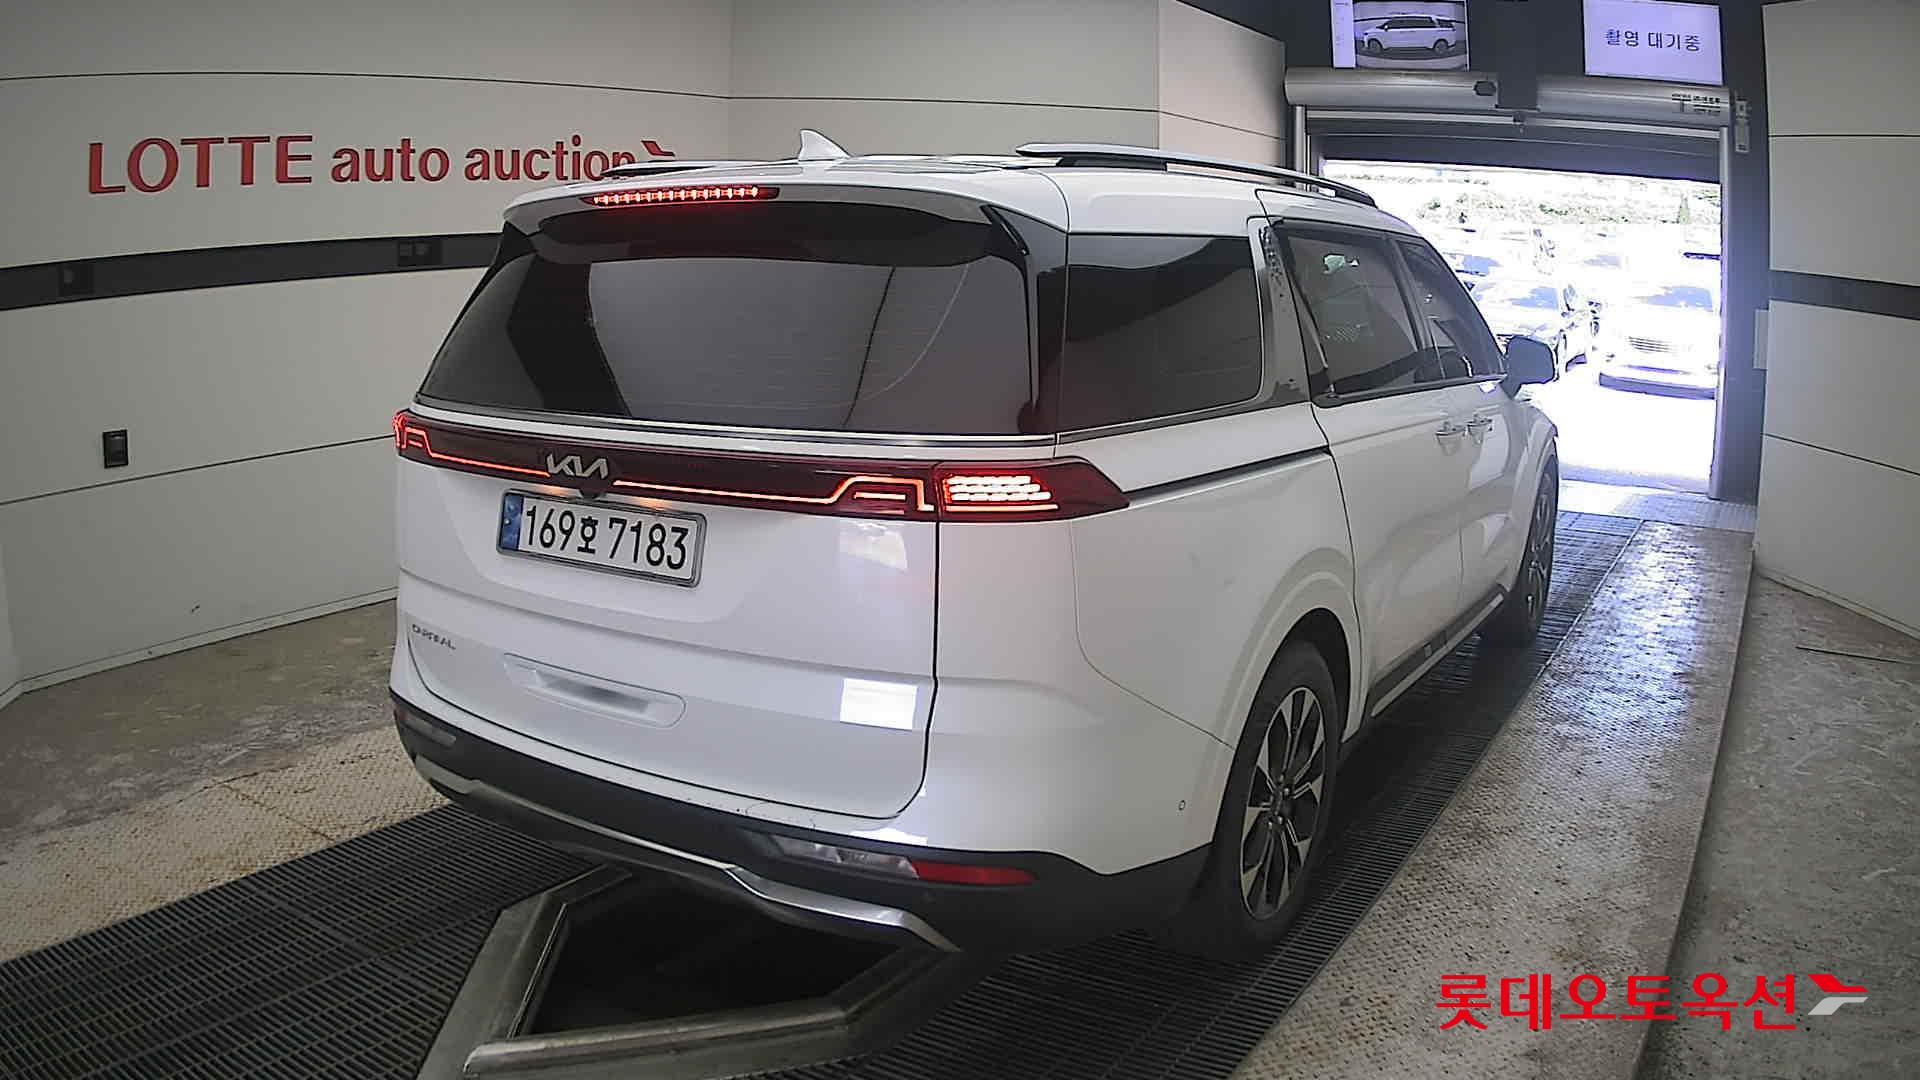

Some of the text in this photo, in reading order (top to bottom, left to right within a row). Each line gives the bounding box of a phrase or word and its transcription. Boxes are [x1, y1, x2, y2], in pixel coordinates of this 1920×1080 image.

[1605, 29, 1701, 52] 촬영 대기중
[88, 134, 636, 195] LOTTE auto auction
[546, 453, 610, 479] KIA
[526, 504, 690, 571] 169호 7183
